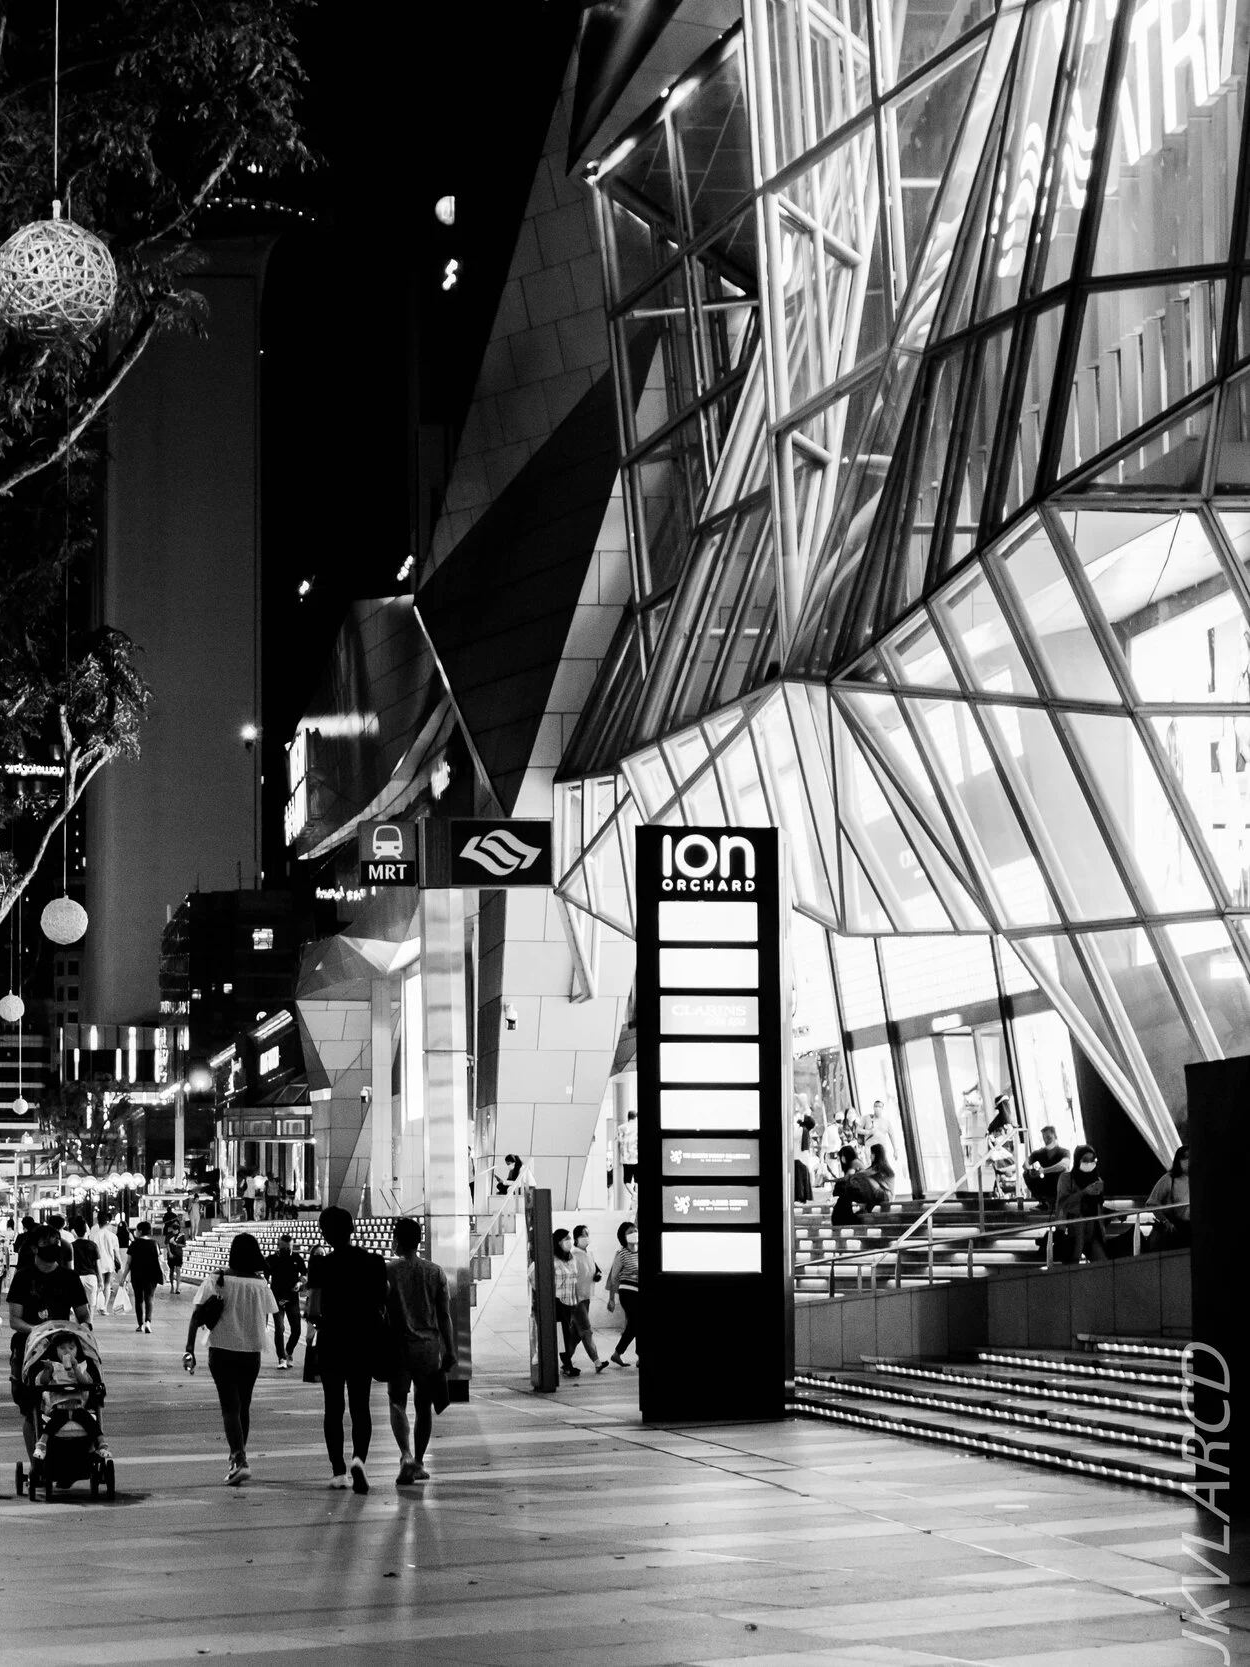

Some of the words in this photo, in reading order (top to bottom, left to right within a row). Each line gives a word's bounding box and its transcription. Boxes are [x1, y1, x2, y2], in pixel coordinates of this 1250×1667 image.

[368, 864, 407, 880] MRT
[661, 879, 756, 891] ORCHARD
[671, 1004, 747, 1017] CLARINS
